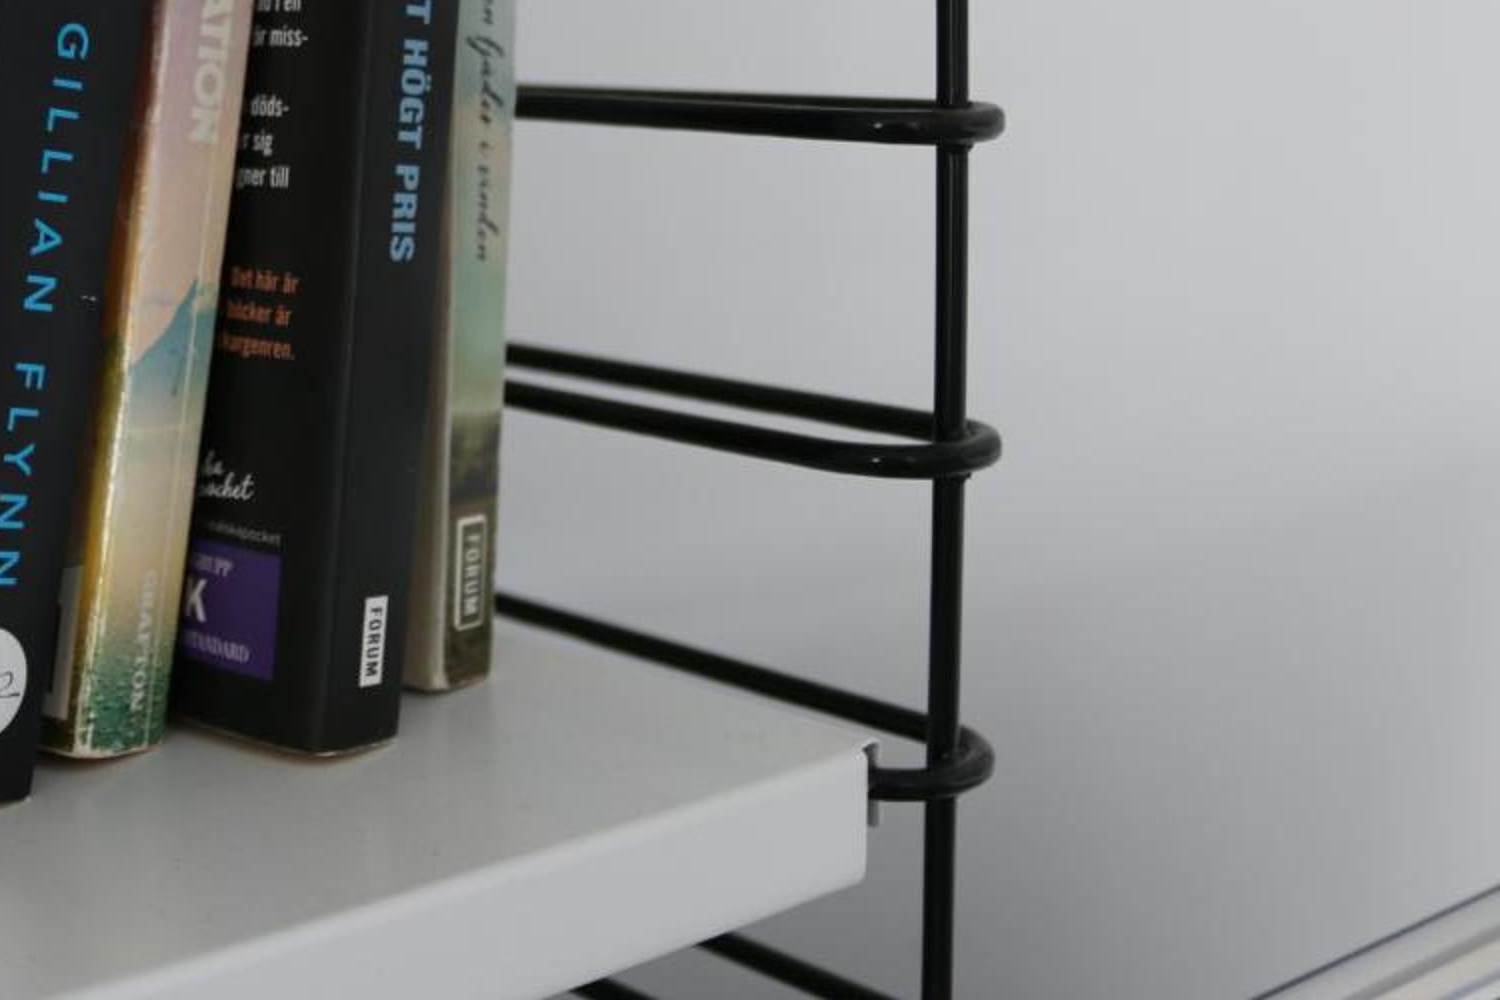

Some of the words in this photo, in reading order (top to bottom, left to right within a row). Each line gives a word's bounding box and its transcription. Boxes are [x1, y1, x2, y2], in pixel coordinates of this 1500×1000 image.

[268, 24, 309, 48] miss-
[250, 93, 290, 117] döds-
[398, 39, 432, 150] HÖGT
[22, 22, 90, 312] GILLIAN
[252, 130, 273, 156] sig
[270, 165, 290, 188] till
[389, 164, 421, 262] PRIS
[463, 533, 482, 616] FORUM
[365, 604, 384, 678] FORUM
